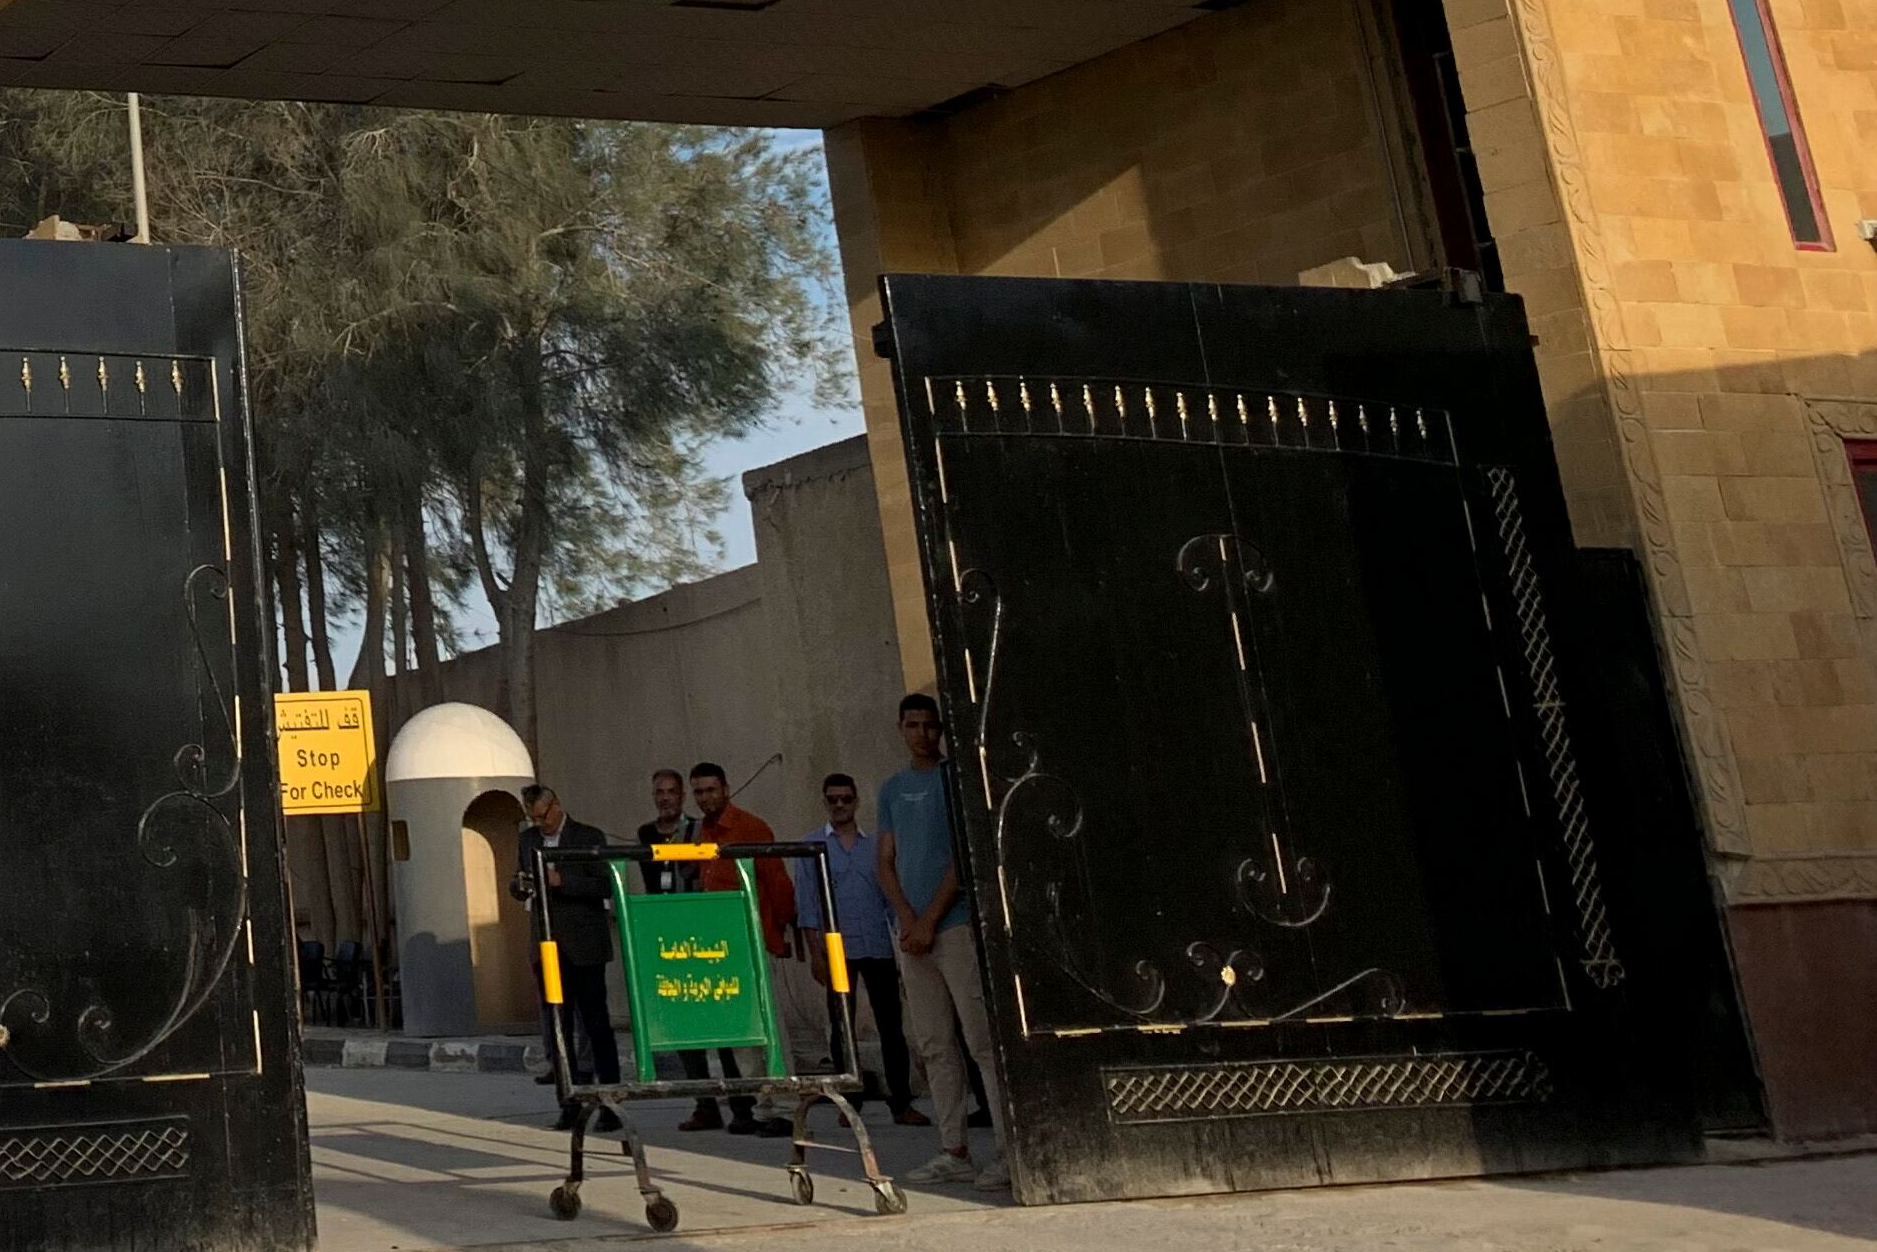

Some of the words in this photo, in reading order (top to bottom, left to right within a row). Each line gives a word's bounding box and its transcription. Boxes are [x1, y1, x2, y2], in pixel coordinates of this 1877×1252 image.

[337, 707, 360, 729] قف
[297, 749, 340, 770] Stop
[311, 779, 364, 800] Check
